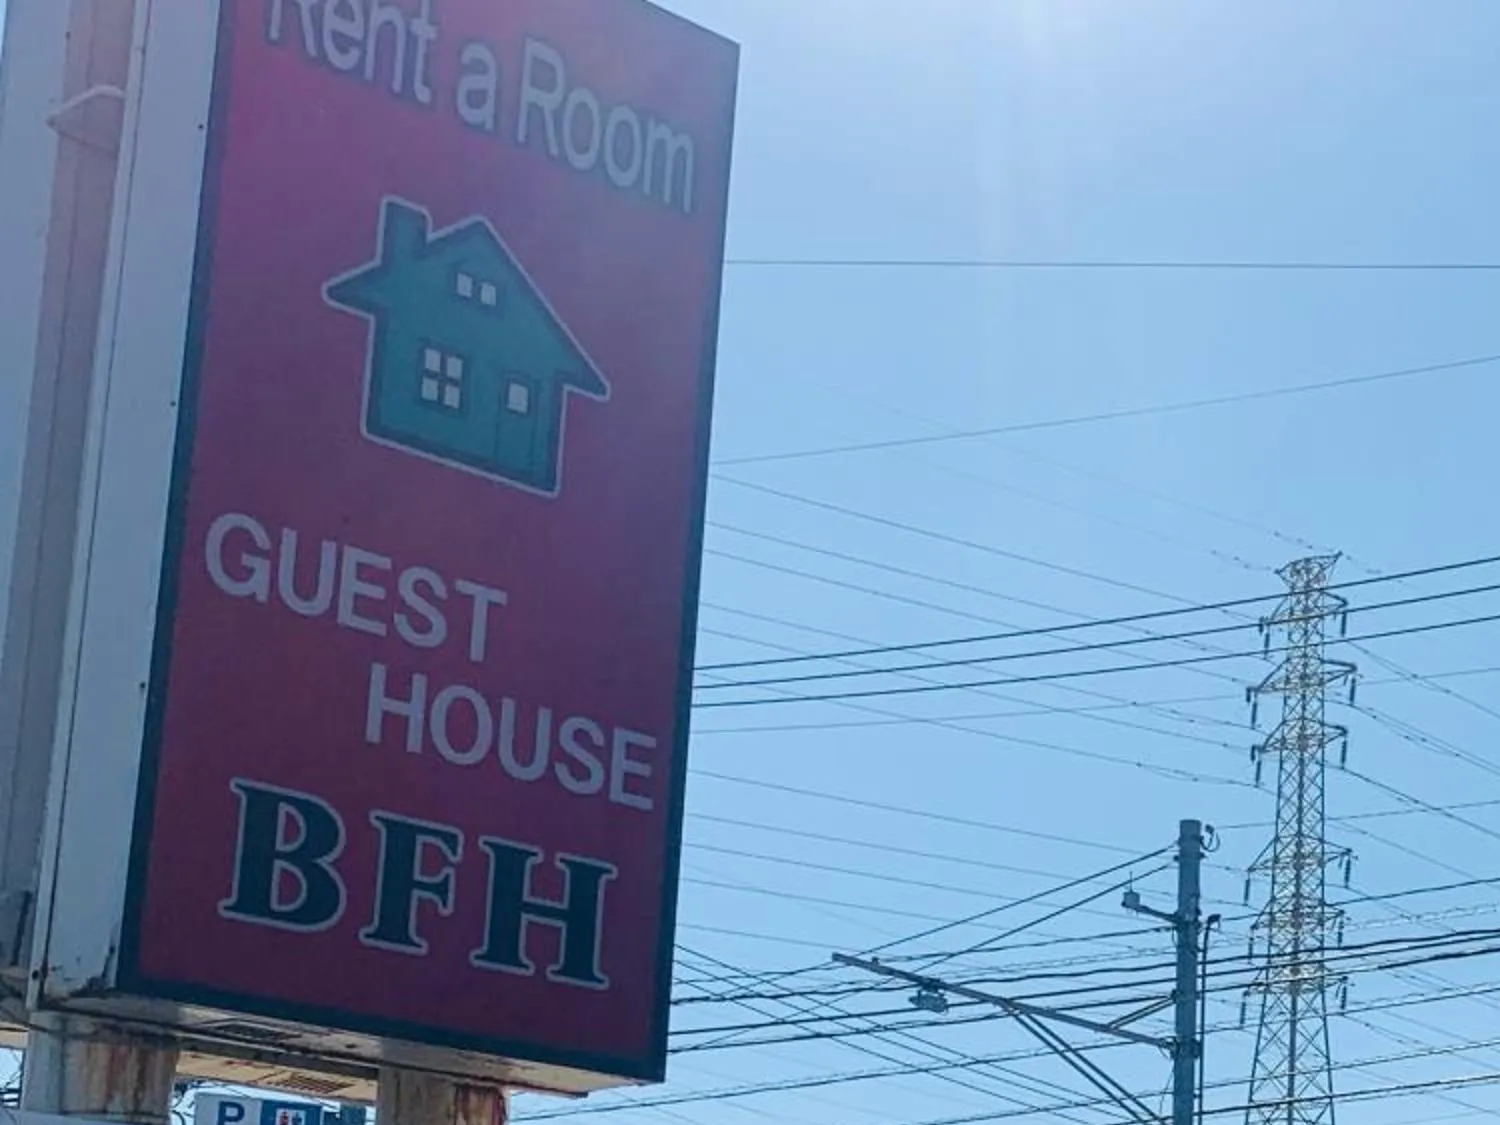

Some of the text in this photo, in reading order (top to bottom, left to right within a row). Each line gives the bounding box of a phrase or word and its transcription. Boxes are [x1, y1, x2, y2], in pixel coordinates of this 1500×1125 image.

[456, 41, 499, 131] a
[517, 36, 695, 213] Room
[205, 513, 506, 662] GUEST
[365, 664, 657, 810] HOUSE
[218, 776, 617, 990] BFH
